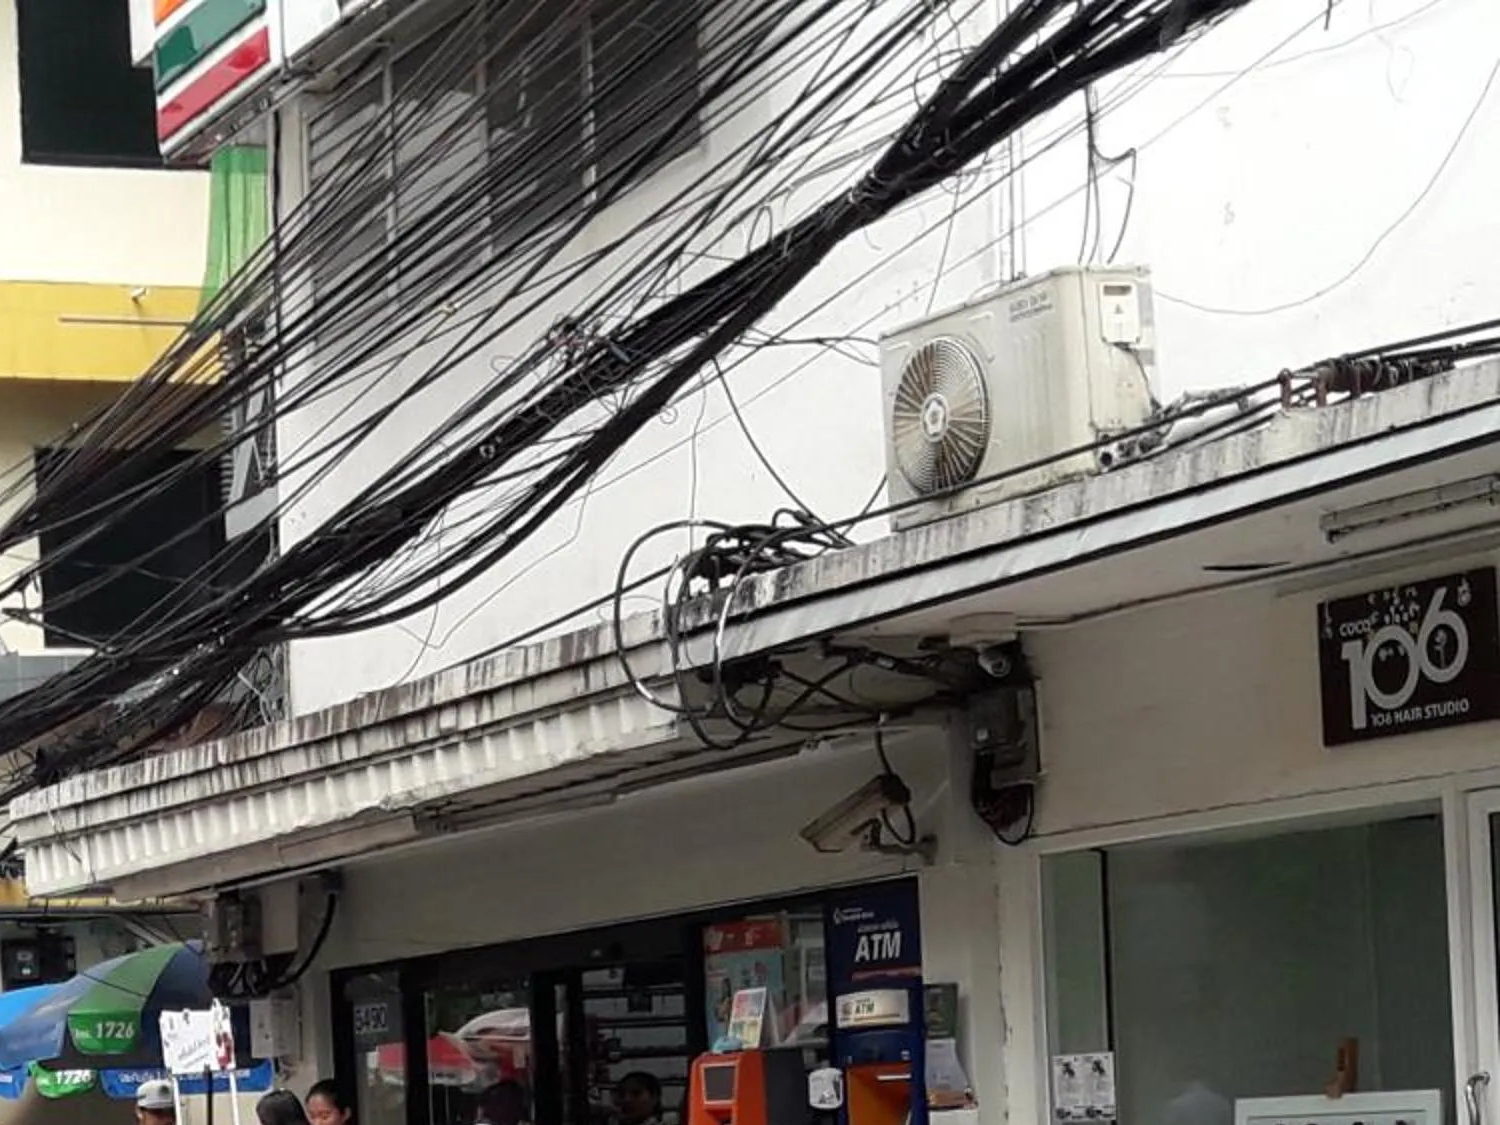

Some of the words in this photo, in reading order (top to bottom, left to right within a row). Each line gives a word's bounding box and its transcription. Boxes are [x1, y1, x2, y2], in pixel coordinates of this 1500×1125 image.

[1341, 586, 1469, 730] 106
[1394, 705, 1422, 722] HAIR
[1424, 698, 1470, 719] STUDIO
[855, 931, 900, 962] ATM
[96, 1021, 135, 1040] 1726
[56, 1069, 92, 1085] 1726
